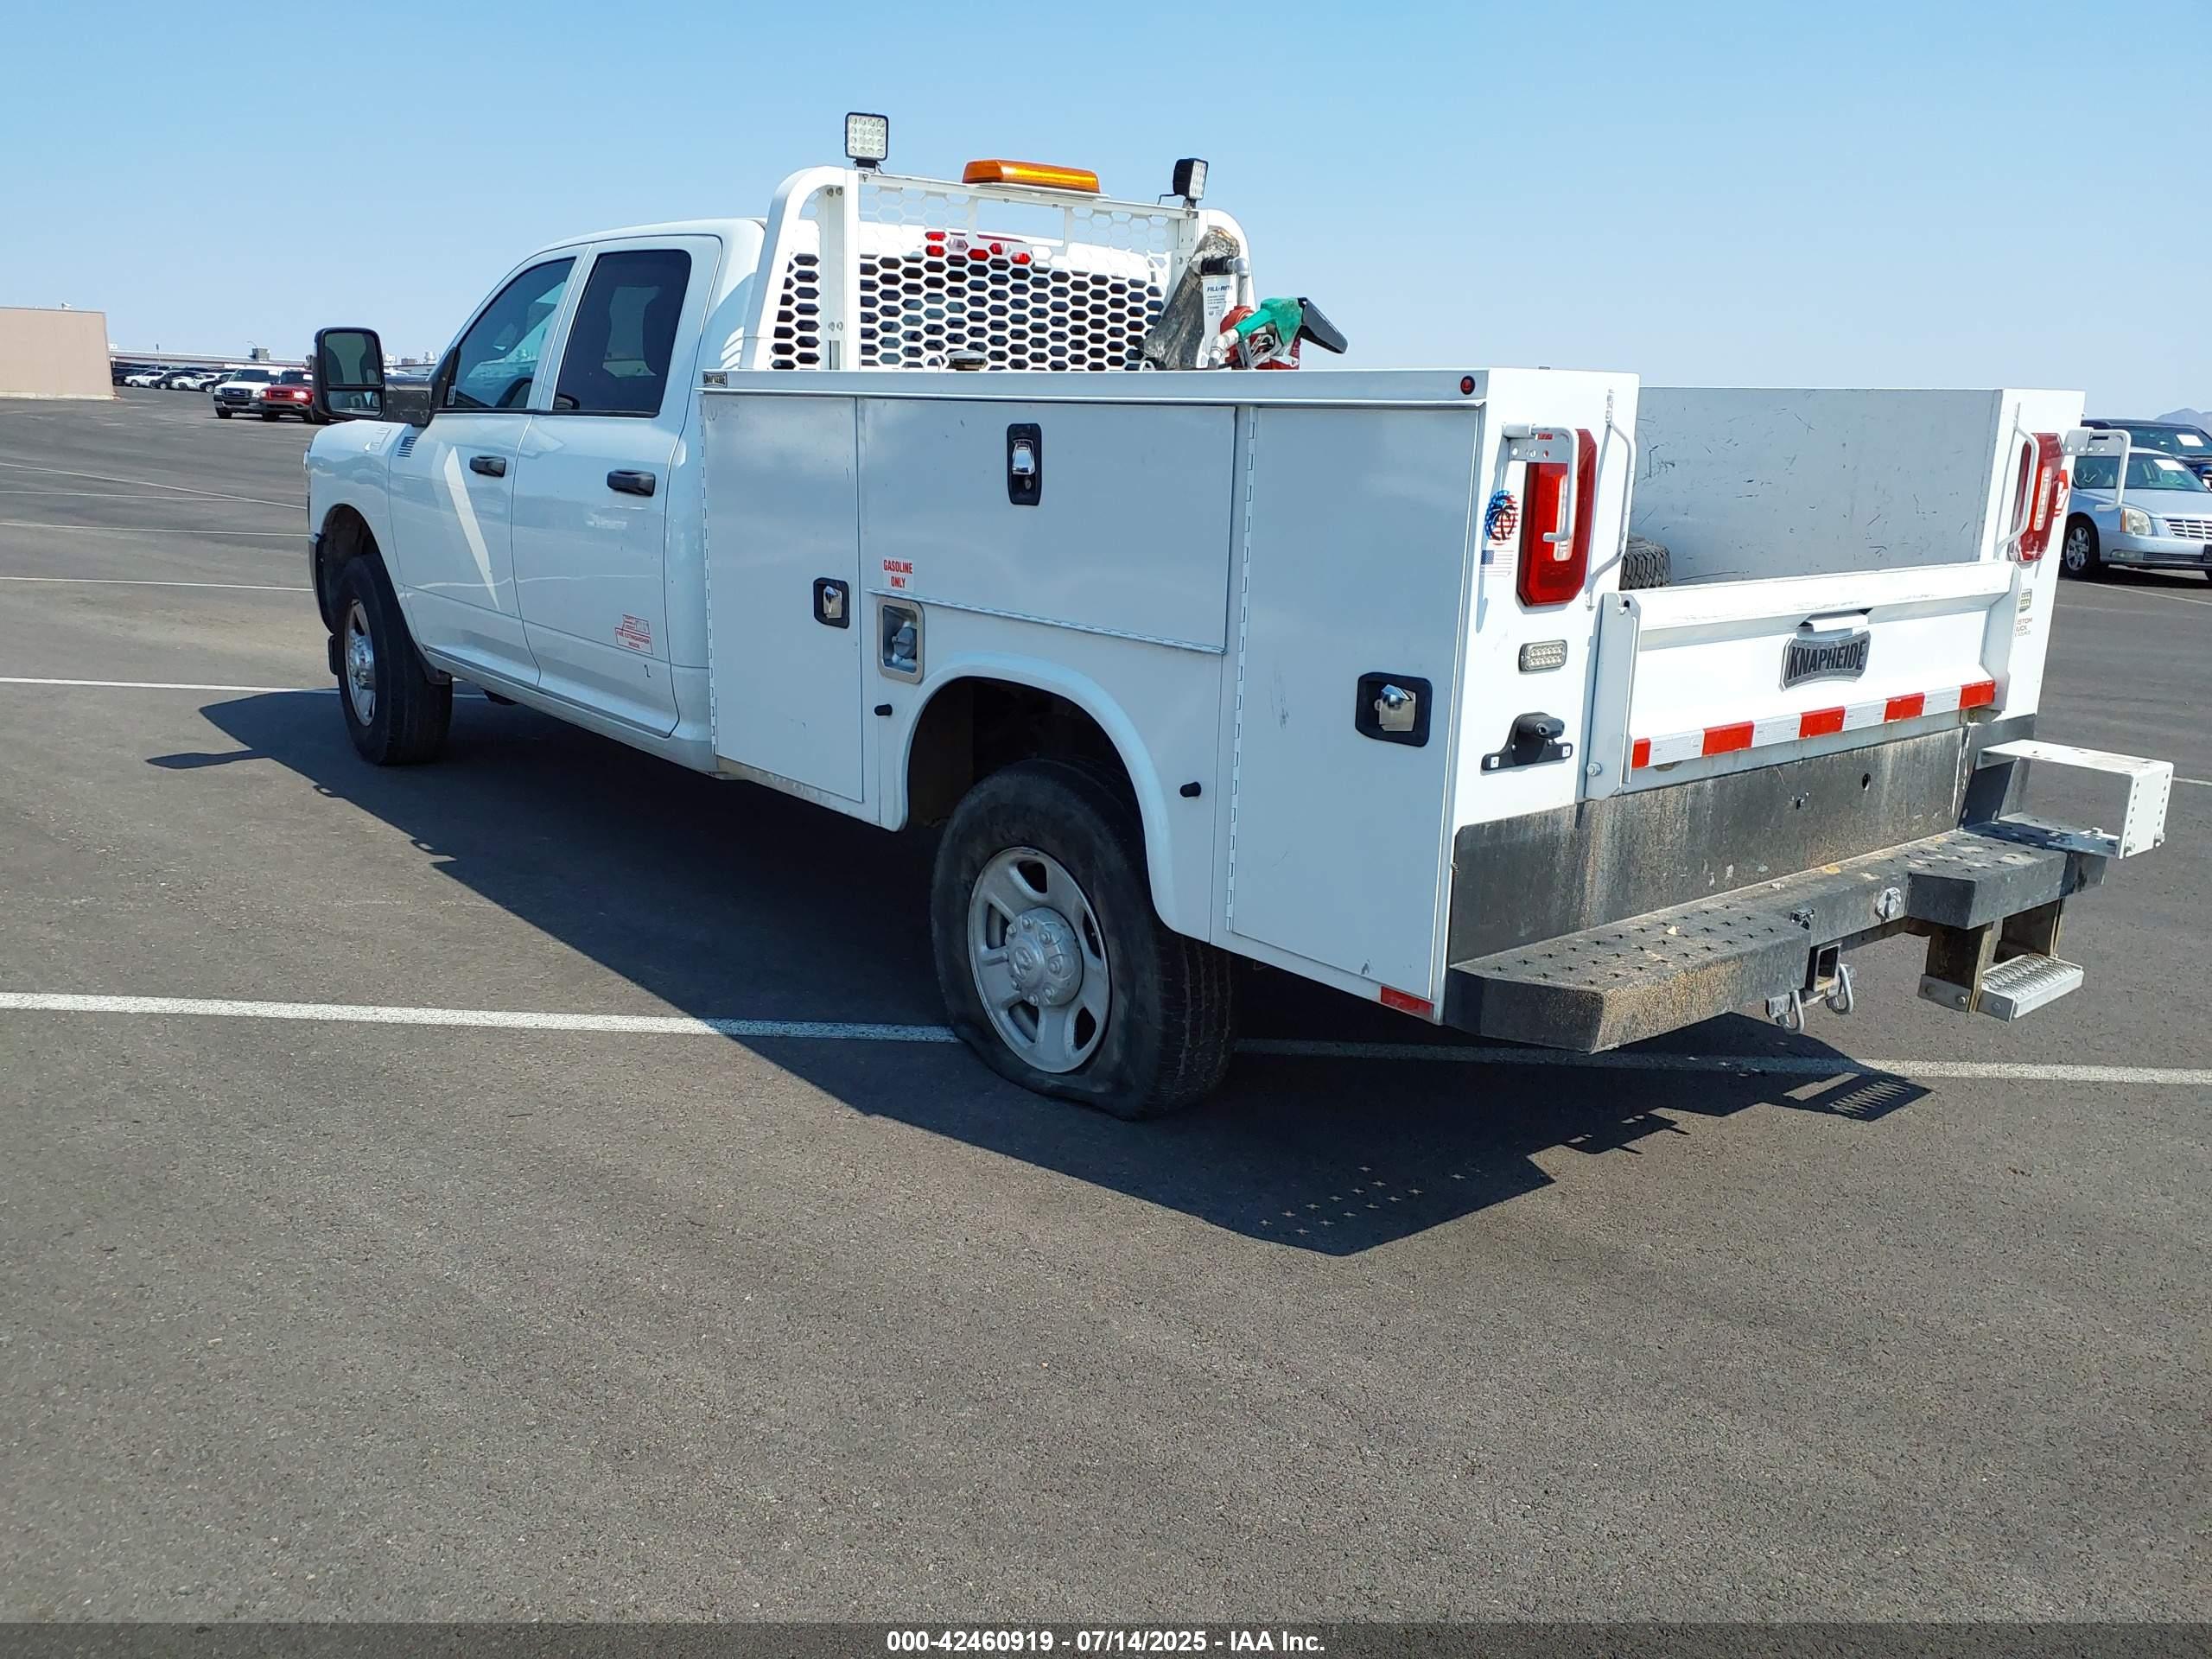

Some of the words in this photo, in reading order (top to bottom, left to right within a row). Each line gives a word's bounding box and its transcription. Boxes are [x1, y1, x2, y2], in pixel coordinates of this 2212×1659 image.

[883, 559, 913, 575] GASOLINE
[891, 575, 906, 588] ONLY
[1788, 639, 1866, 680] KNAPHEIDE
